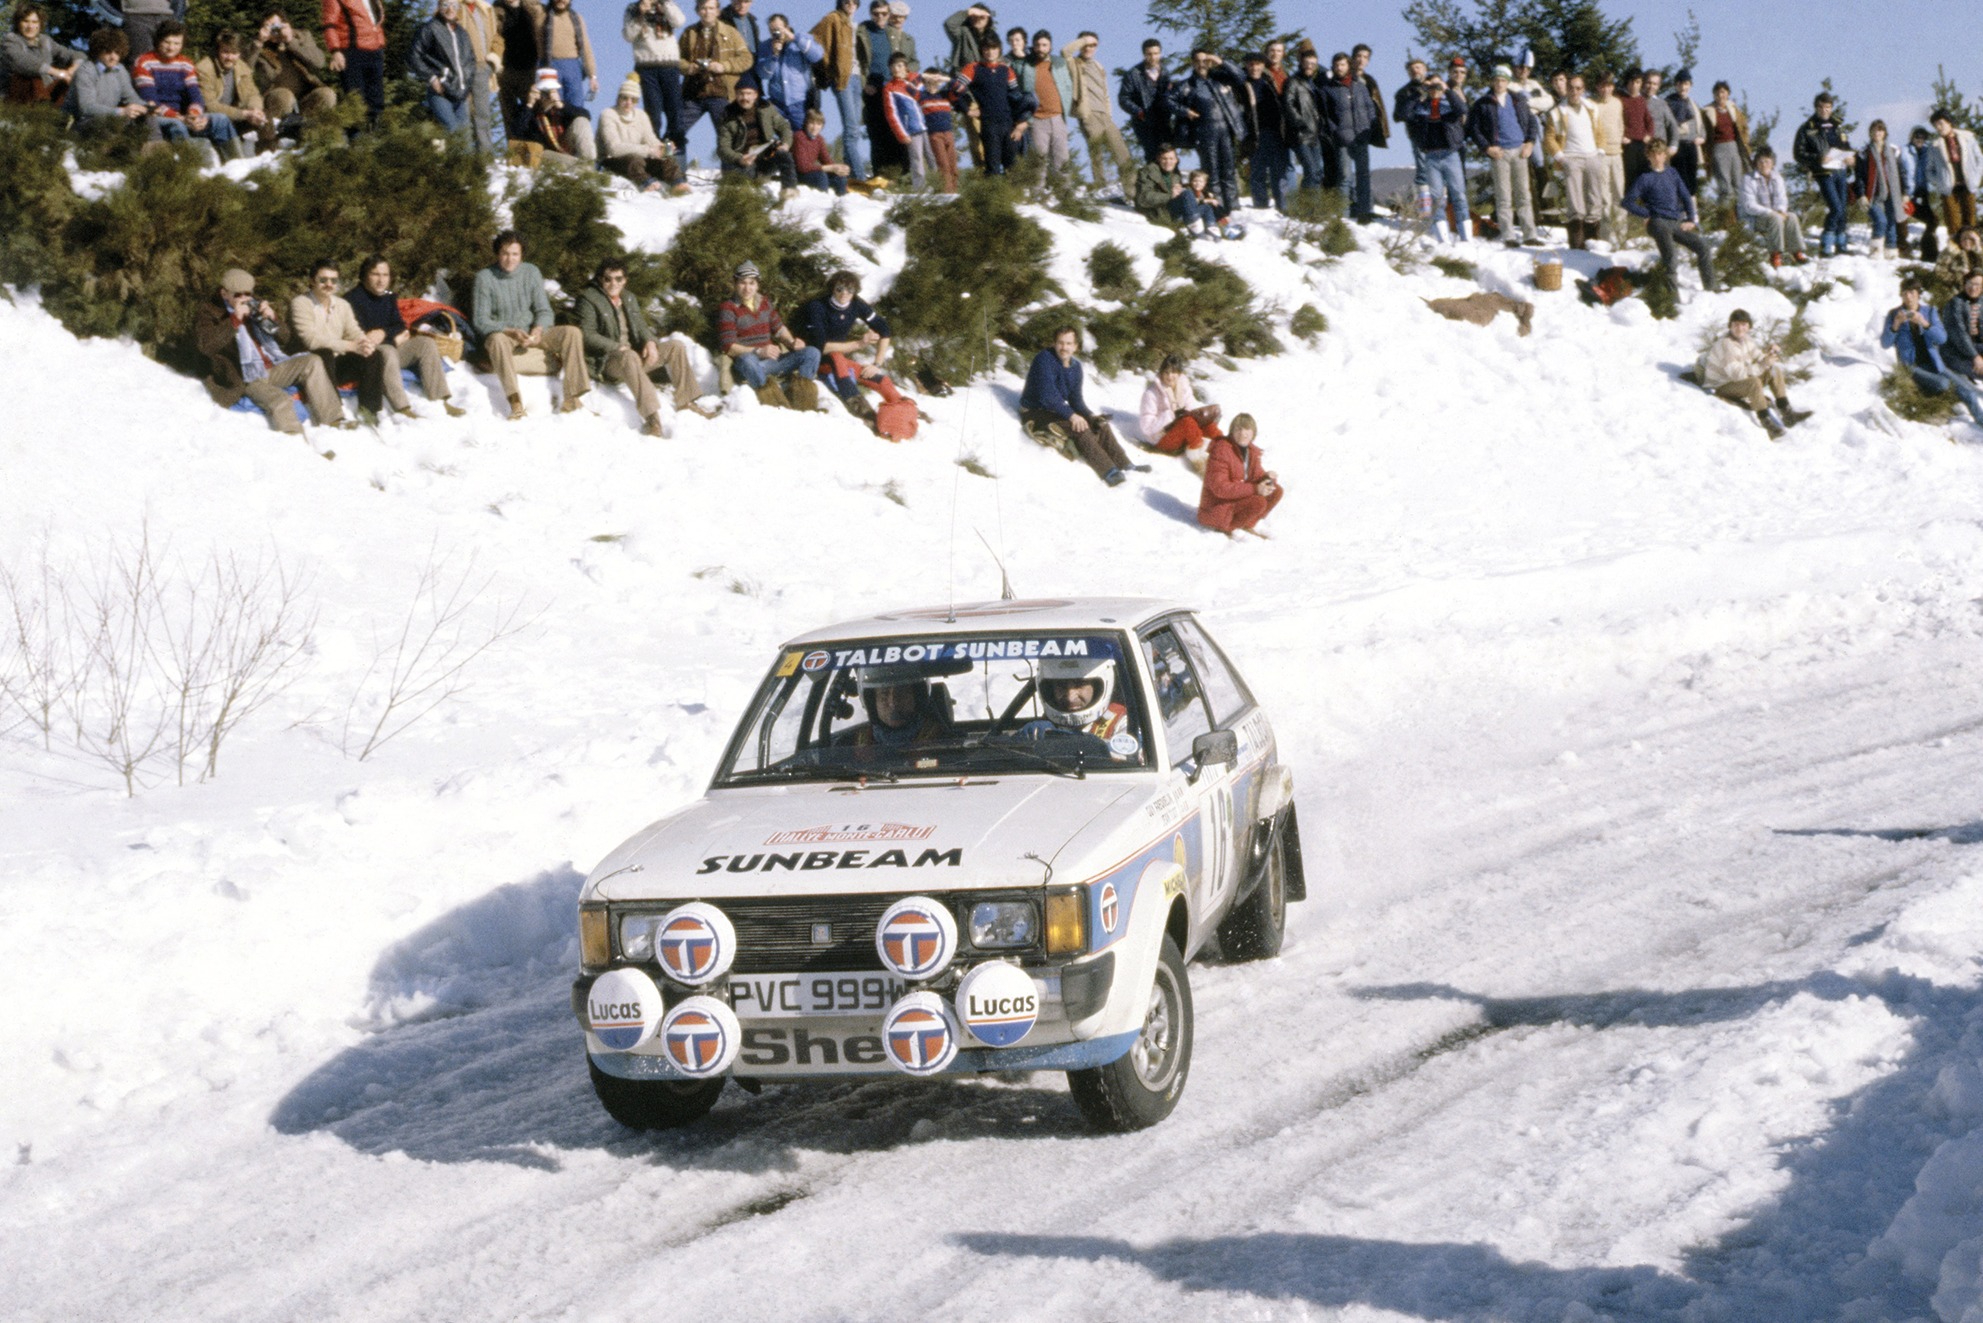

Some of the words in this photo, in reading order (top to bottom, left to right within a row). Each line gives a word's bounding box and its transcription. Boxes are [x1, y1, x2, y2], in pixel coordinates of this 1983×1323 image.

[835, 644, 945, 666] TALBOT
[953, 640, 1088, 659] SUNBEAM
[842, 824, 872, 832] 16
[696, 848, 963, 875] SUNBEAM
[729, 979, 802, 1012] PVC
[969, 995, 1035, 1016] Lucas
[589, 999, 642, 1021] Lucas
[742, 1027, 888, 1065] She
